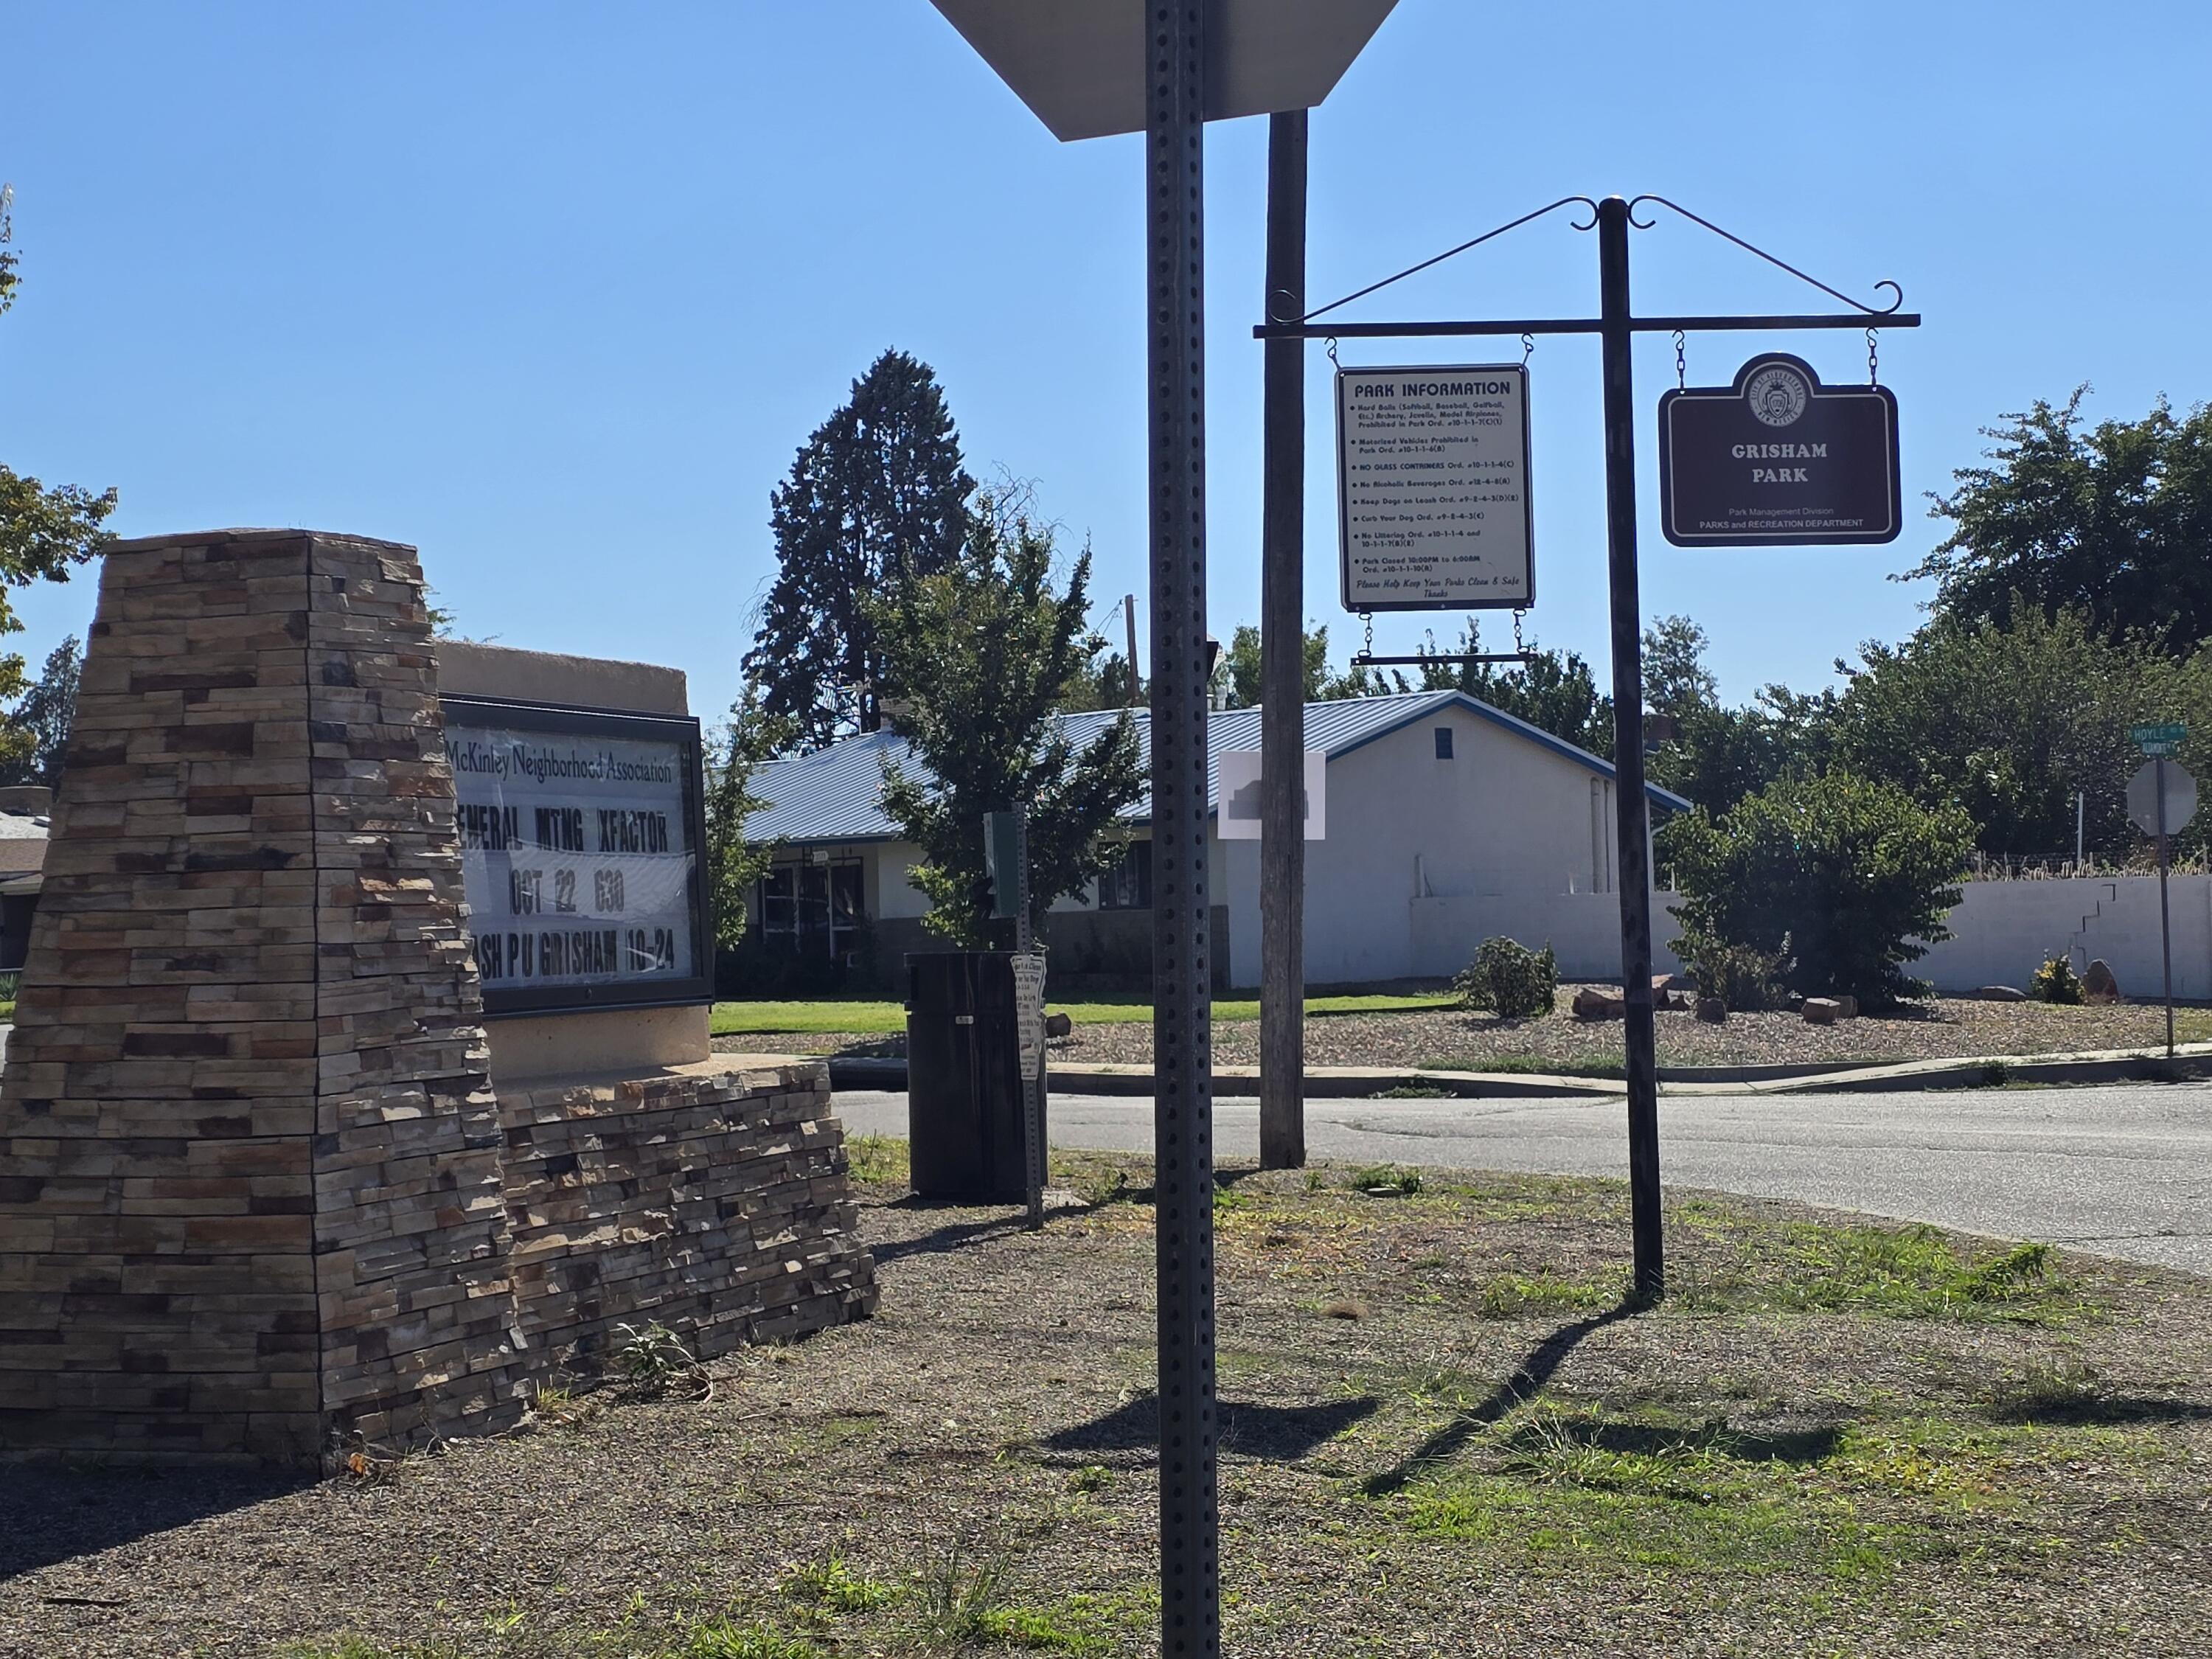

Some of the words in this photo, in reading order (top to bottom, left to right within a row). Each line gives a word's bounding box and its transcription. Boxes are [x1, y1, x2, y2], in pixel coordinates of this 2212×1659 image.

[1354, 384, 1394, 397] PARK
[1402, 382, 1510, 396] INFORMATION
[1376, 412, 1405, 420] Archery,
[1732, 444, 1827, 459] GRISHAM
[1752, 468, 1808, 482] PARK
[1749, 508, 1801, 517] Management
[1731, 521, 1745, 529] and
[1748, 520, 1803, 528] RECREATION
[1806, 519, 1863, 527] DEPARTMENT
[1357, 580, 1380, 588] Please
[1383, 580, 1399, 589] Help
[1403, 580, 1420, 588] Keep
[1425, 579, 1441, 587] Your
[1445, 578, 1464, 586] Parks
[1468, 577, 1488, 585] Clean
[1502, 577, 1519, 585] Safe
[2134, 728, 2166, 740] HOYLE
[445, 741, 509, 781] McKinley
[512, 745, 602, 784] Neighborhood
[607, 751, 672, 783] Association
[457, 804, 523, 850] ENERAL
[535, 808, 583, 851] MTNG
[599, 810, 668, 852] XFACTOR
[511, 869, 542, 915] OCT
[554, 869, 576, 912] 22
[540, 930, 617, 976] GRISHAM
[627, 928, 674, 970] 10-24
